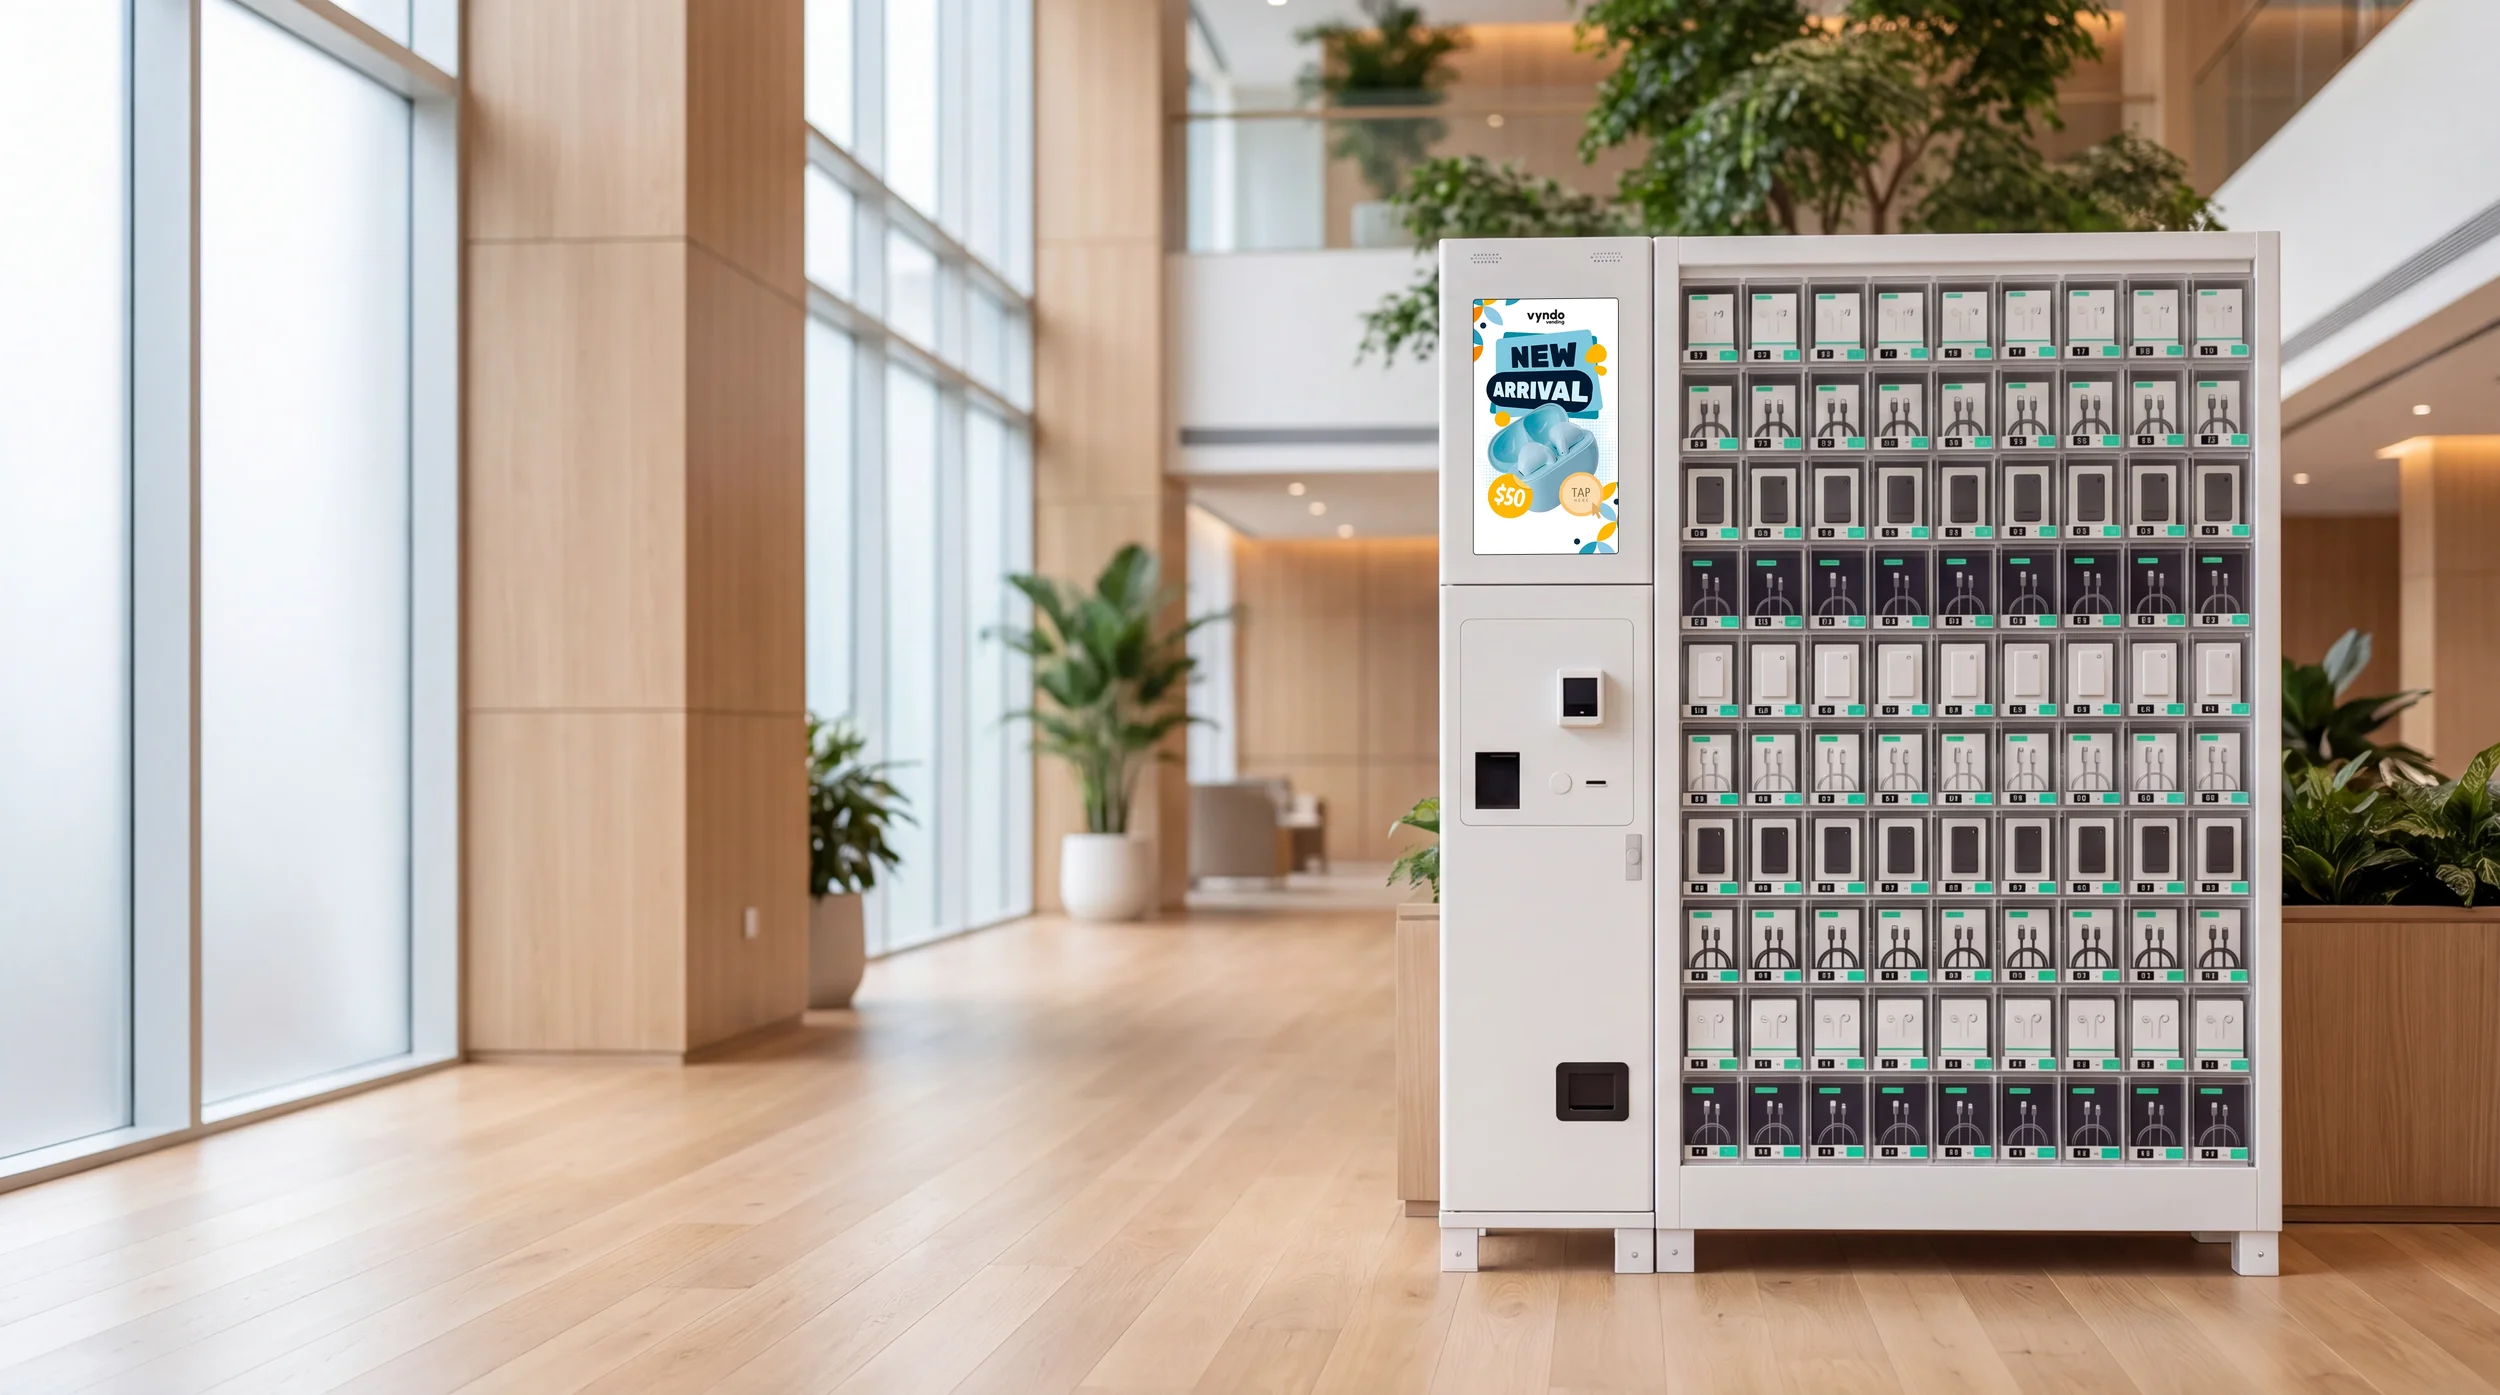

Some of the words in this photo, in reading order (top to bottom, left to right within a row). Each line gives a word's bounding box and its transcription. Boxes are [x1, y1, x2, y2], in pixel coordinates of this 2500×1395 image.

[1527, 309, 1566, 323] vyndo
[1510, 342, 1577, 368] NEW
[1492, 380, 1588, 403] ARRIVAL
[1494, 484, 1526, 508] $50
[1571, 486, 1591, 498] TAP
